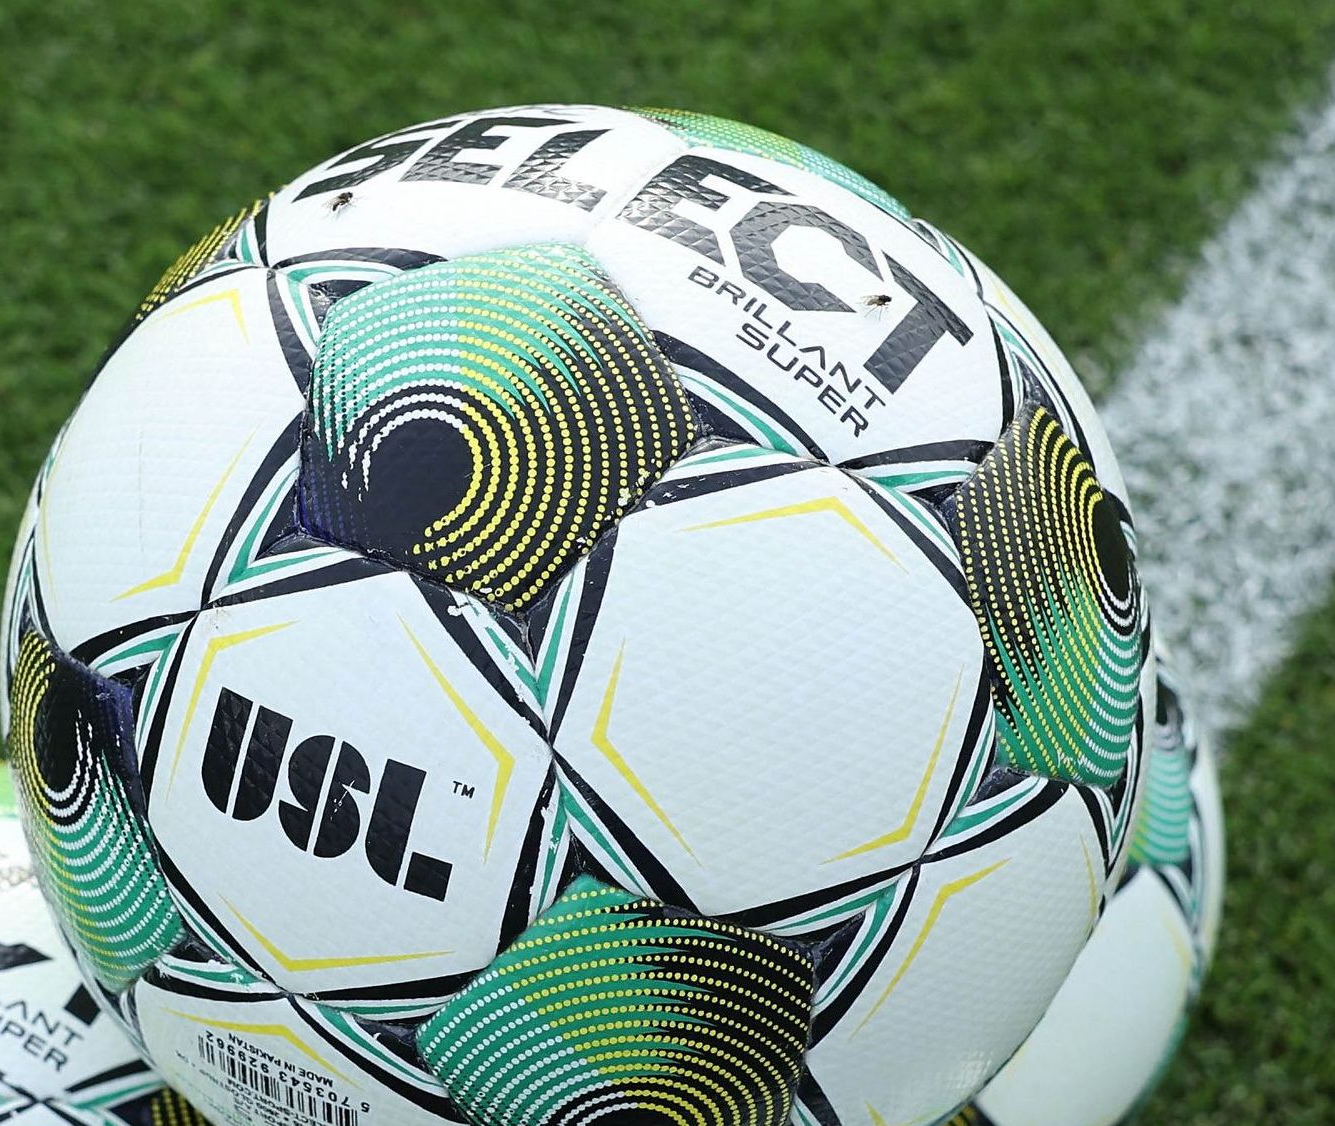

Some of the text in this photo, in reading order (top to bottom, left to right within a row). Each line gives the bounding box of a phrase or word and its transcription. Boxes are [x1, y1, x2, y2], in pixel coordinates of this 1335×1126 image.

[291, 117, 974, 395] SELECT
[687, 265, 888, 410] BRILLANT
[735, 322, 871, 438] SUPER
[202, 686, 453, 902] USL
[228, 1033, 333, 1088] MADE IN PAKISTAN
